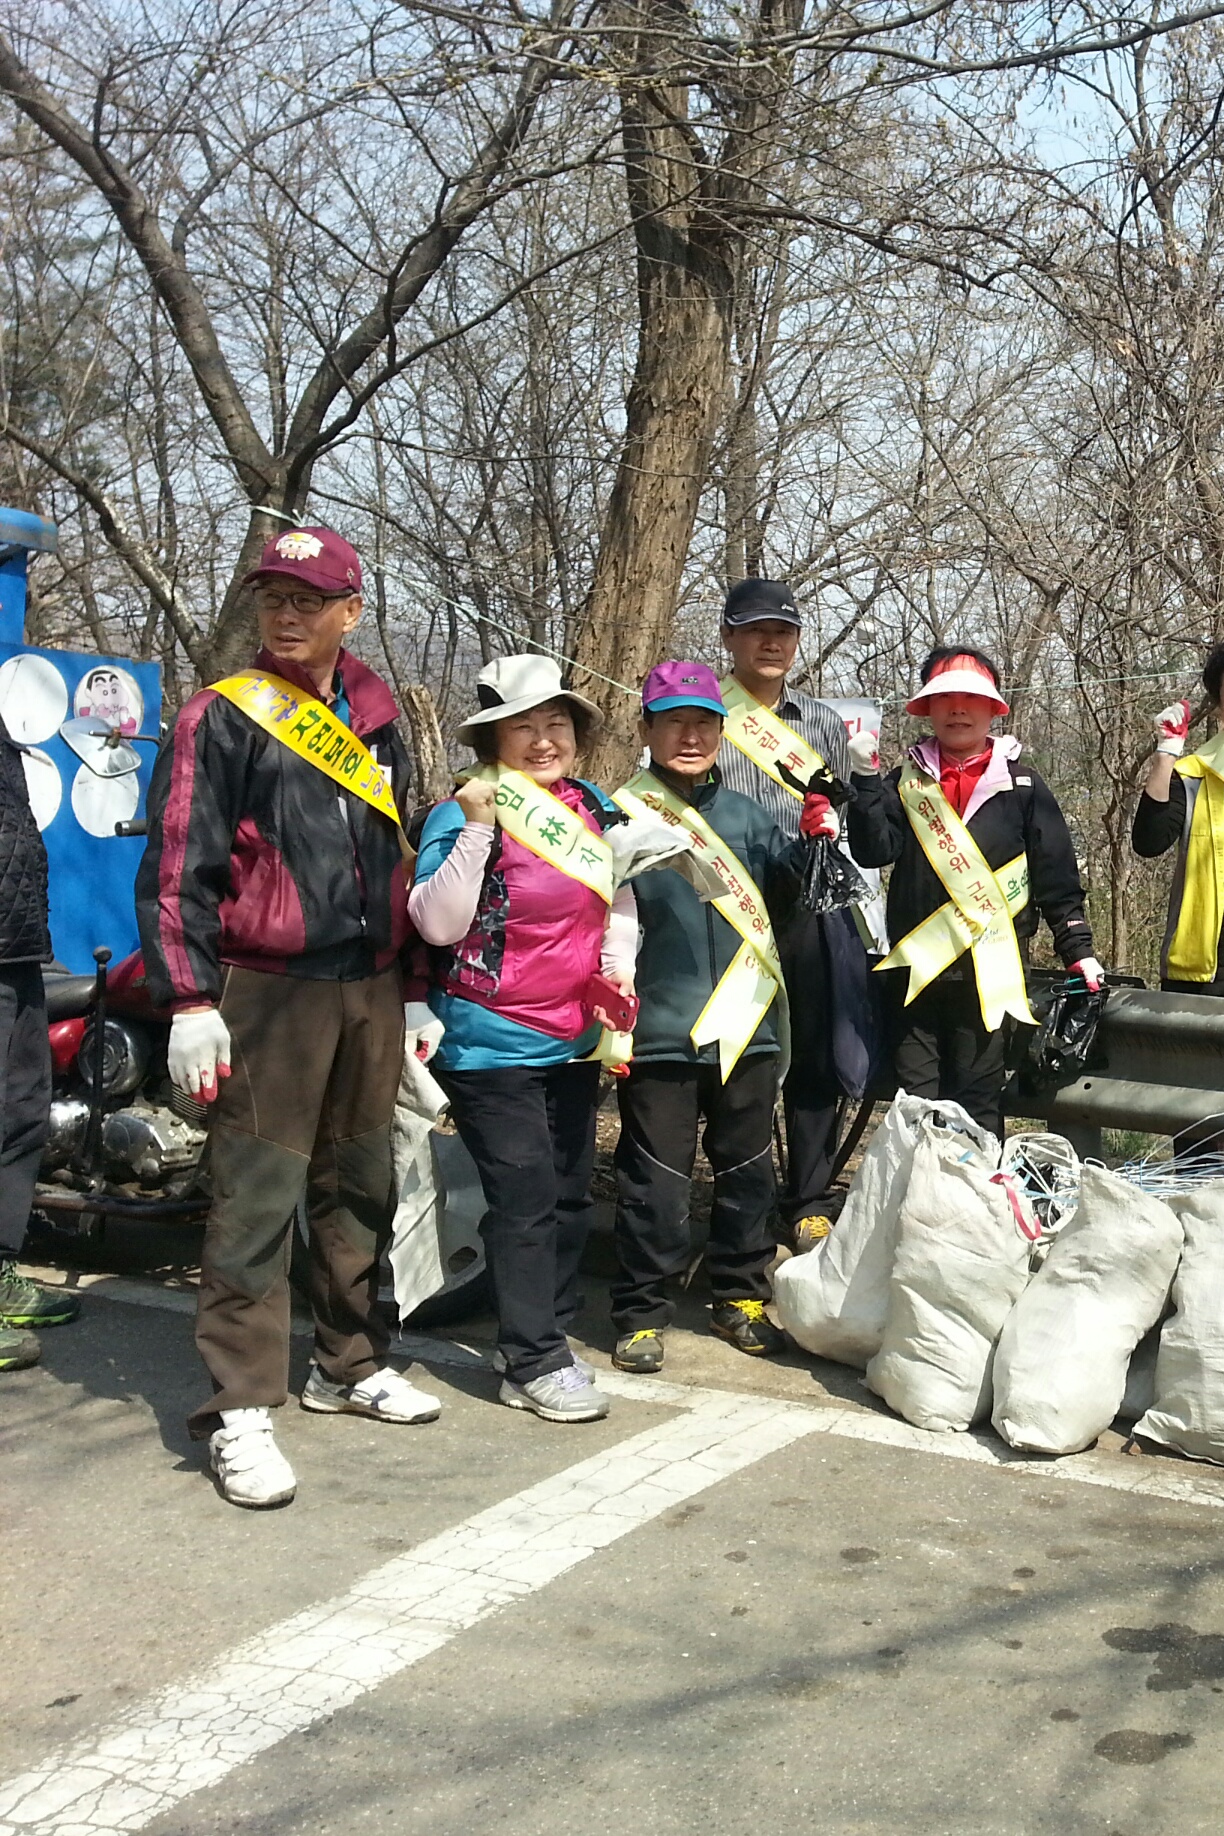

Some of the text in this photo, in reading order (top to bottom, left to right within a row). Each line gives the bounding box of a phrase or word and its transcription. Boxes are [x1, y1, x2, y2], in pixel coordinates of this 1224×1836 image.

[289, 709, 365, 780] 자연보호
[741, 715, 806, 772] 산림 내
[494, 783, 604, 871] 임(林)자
[918, 796, 971, 874] 위법행위
